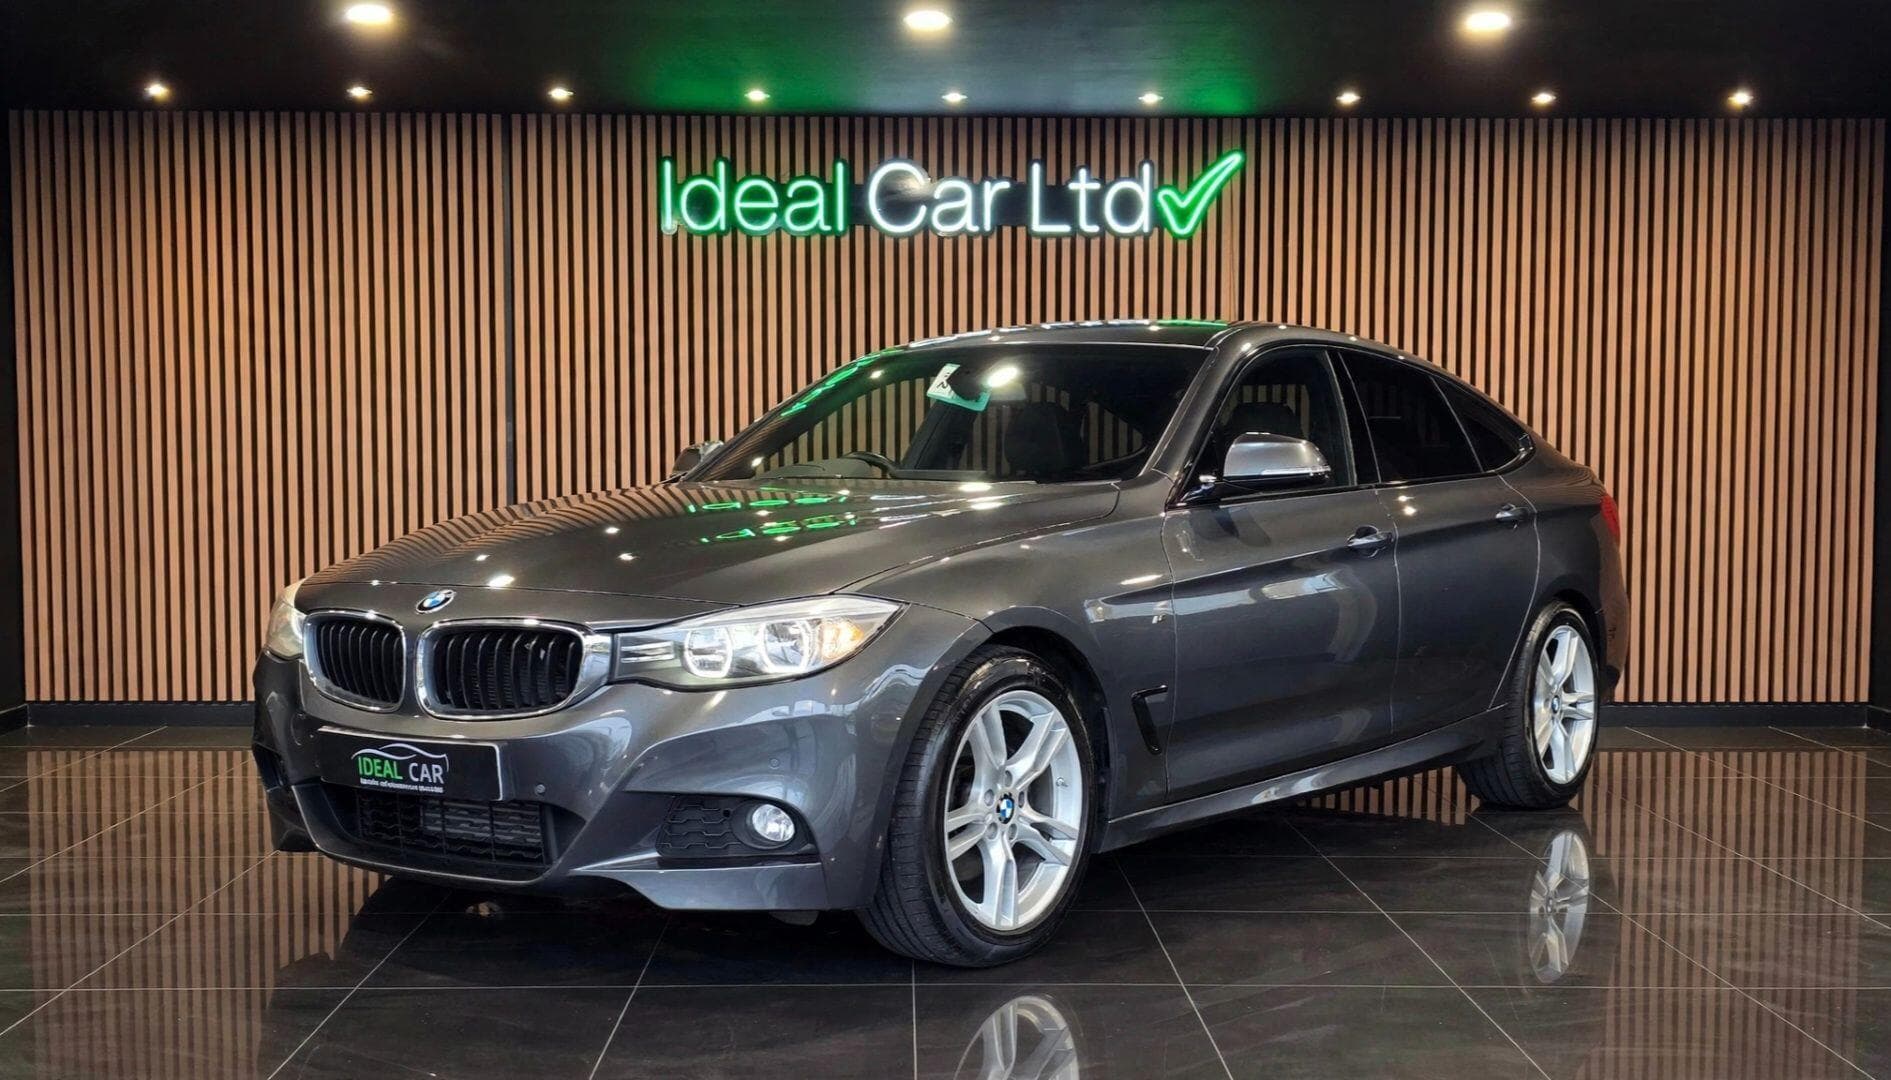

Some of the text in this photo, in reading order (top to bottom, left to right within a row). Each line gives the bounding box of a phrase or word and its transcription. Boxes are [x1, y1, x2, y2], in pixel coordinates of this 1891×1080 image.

[662, 159, 1152, 234] Ideal Car Ltd
[357, 756, 445, 784] IDEAL CAR
